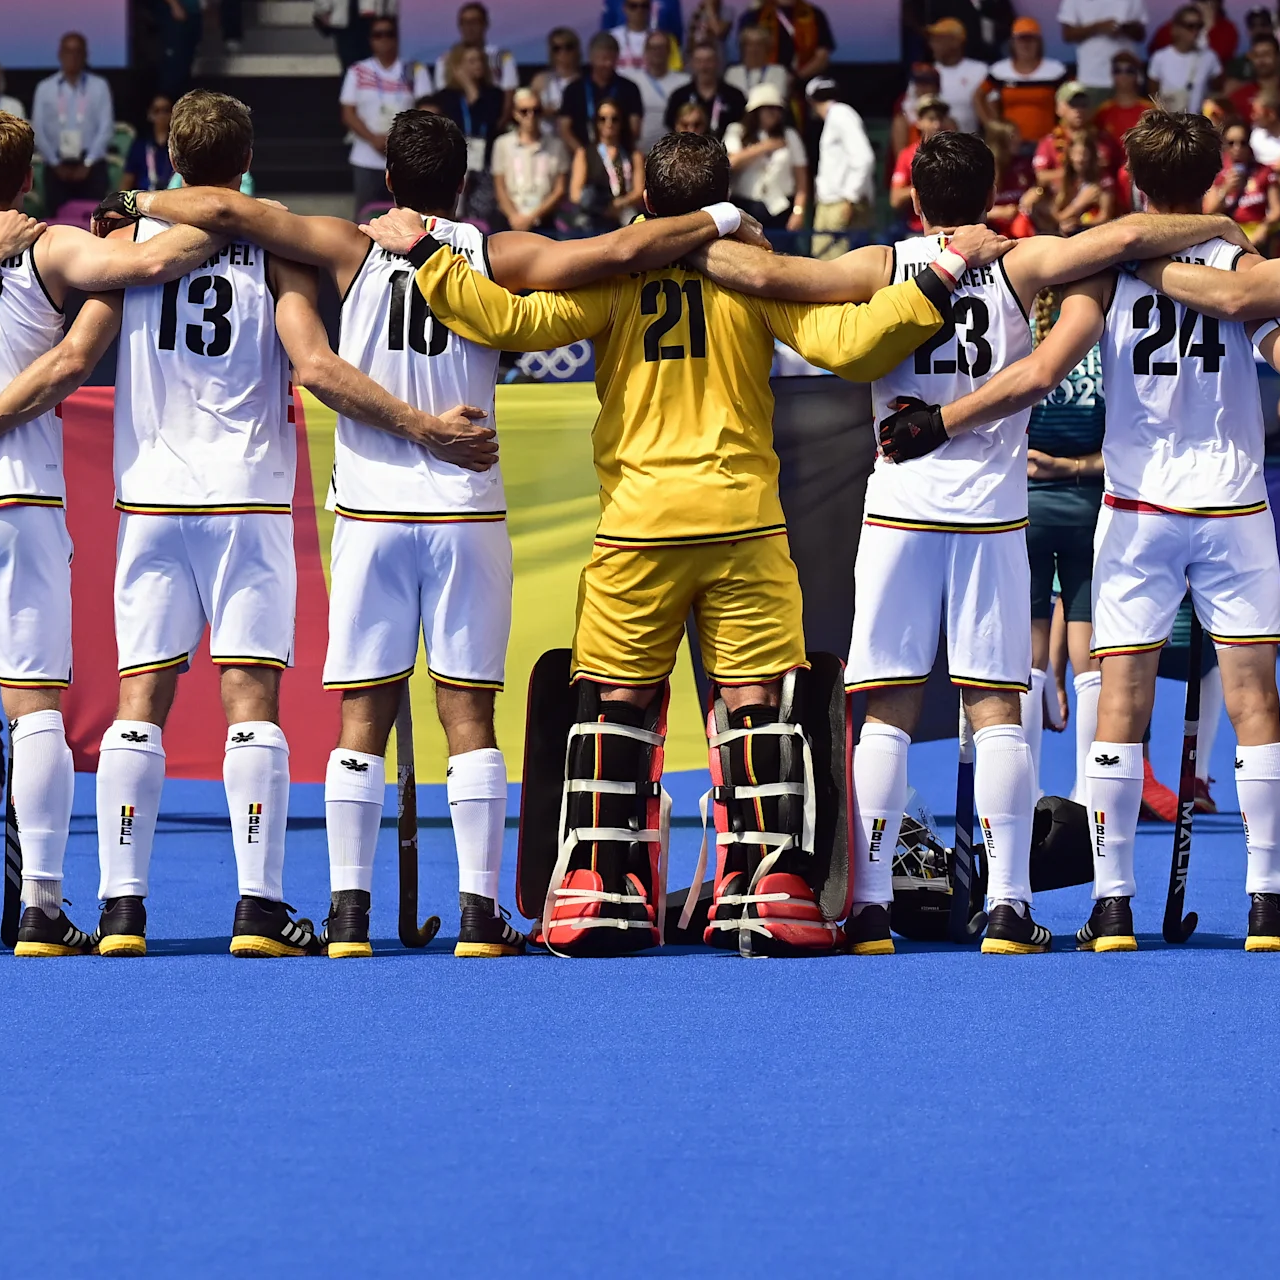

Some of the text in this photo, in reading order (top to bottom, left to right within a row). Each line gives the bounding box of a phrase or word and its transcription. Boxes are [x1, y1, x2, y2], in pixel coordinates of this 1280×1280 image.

[158, 275, 232, 358] 13
[640, 279, 706, 362] 21
[914, 296, 993, 379] 23
[1131, 293, 1225, 376] 24
[120, 816, 133, 845] BEL
[248, 815, 260, 844] BEL
[870, 832, 883, 862] BEL
[1096, 825, 1108, 857] BEL
[1174, 801, 1195, 895] MALIK
